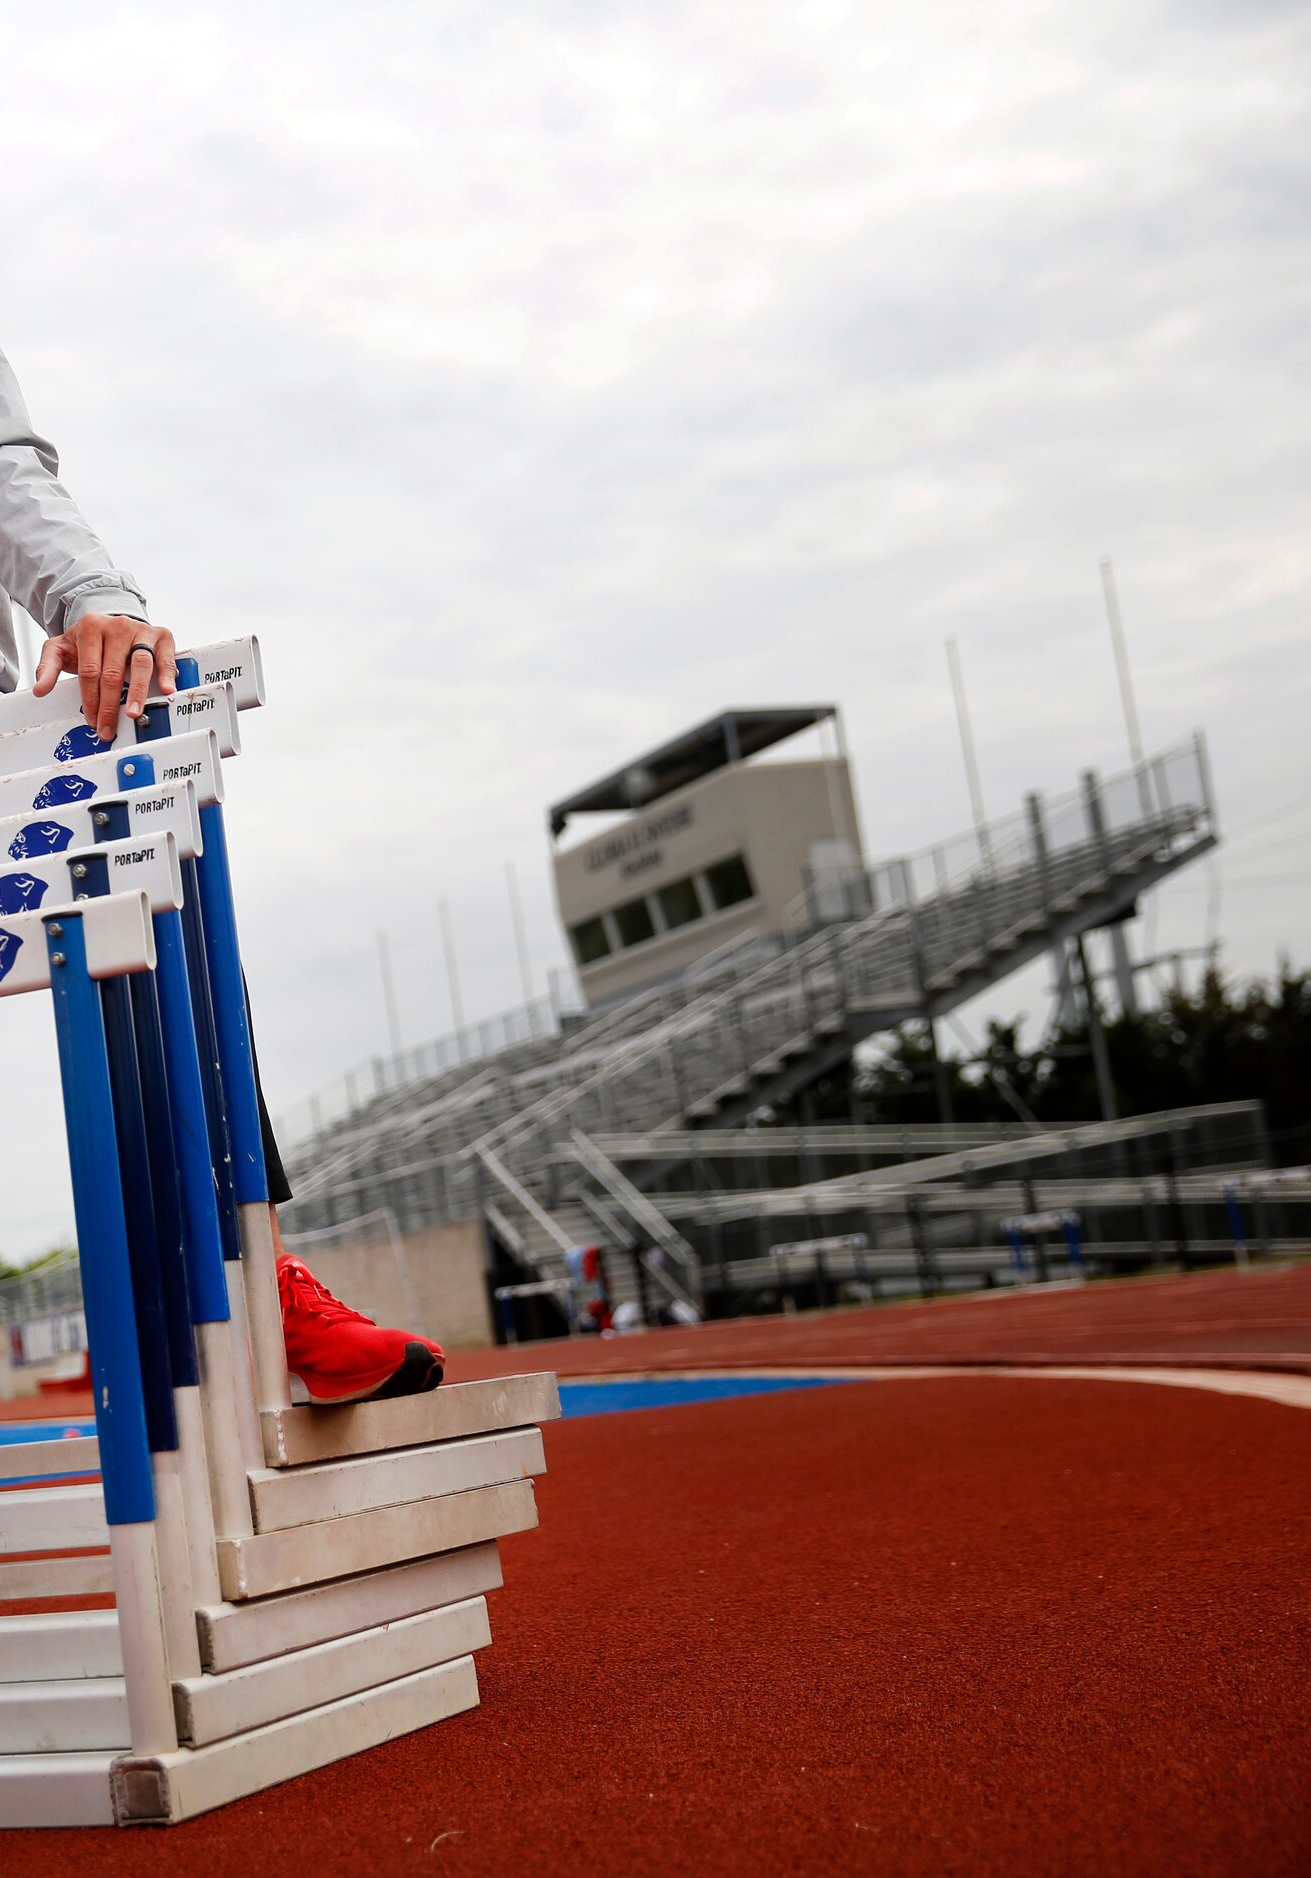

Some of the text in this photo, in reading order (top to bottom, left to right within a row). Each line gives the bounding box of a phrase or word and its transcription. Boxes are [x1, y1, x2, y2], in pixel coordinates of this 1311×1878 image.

[176, 698, 215, 716] PORTaPIT
[163, 763, 202, 780] PORTaPIT
[135, 797, 175, 814] PORTaPIT
[114, 848, 155, 867] PORTaPIT
